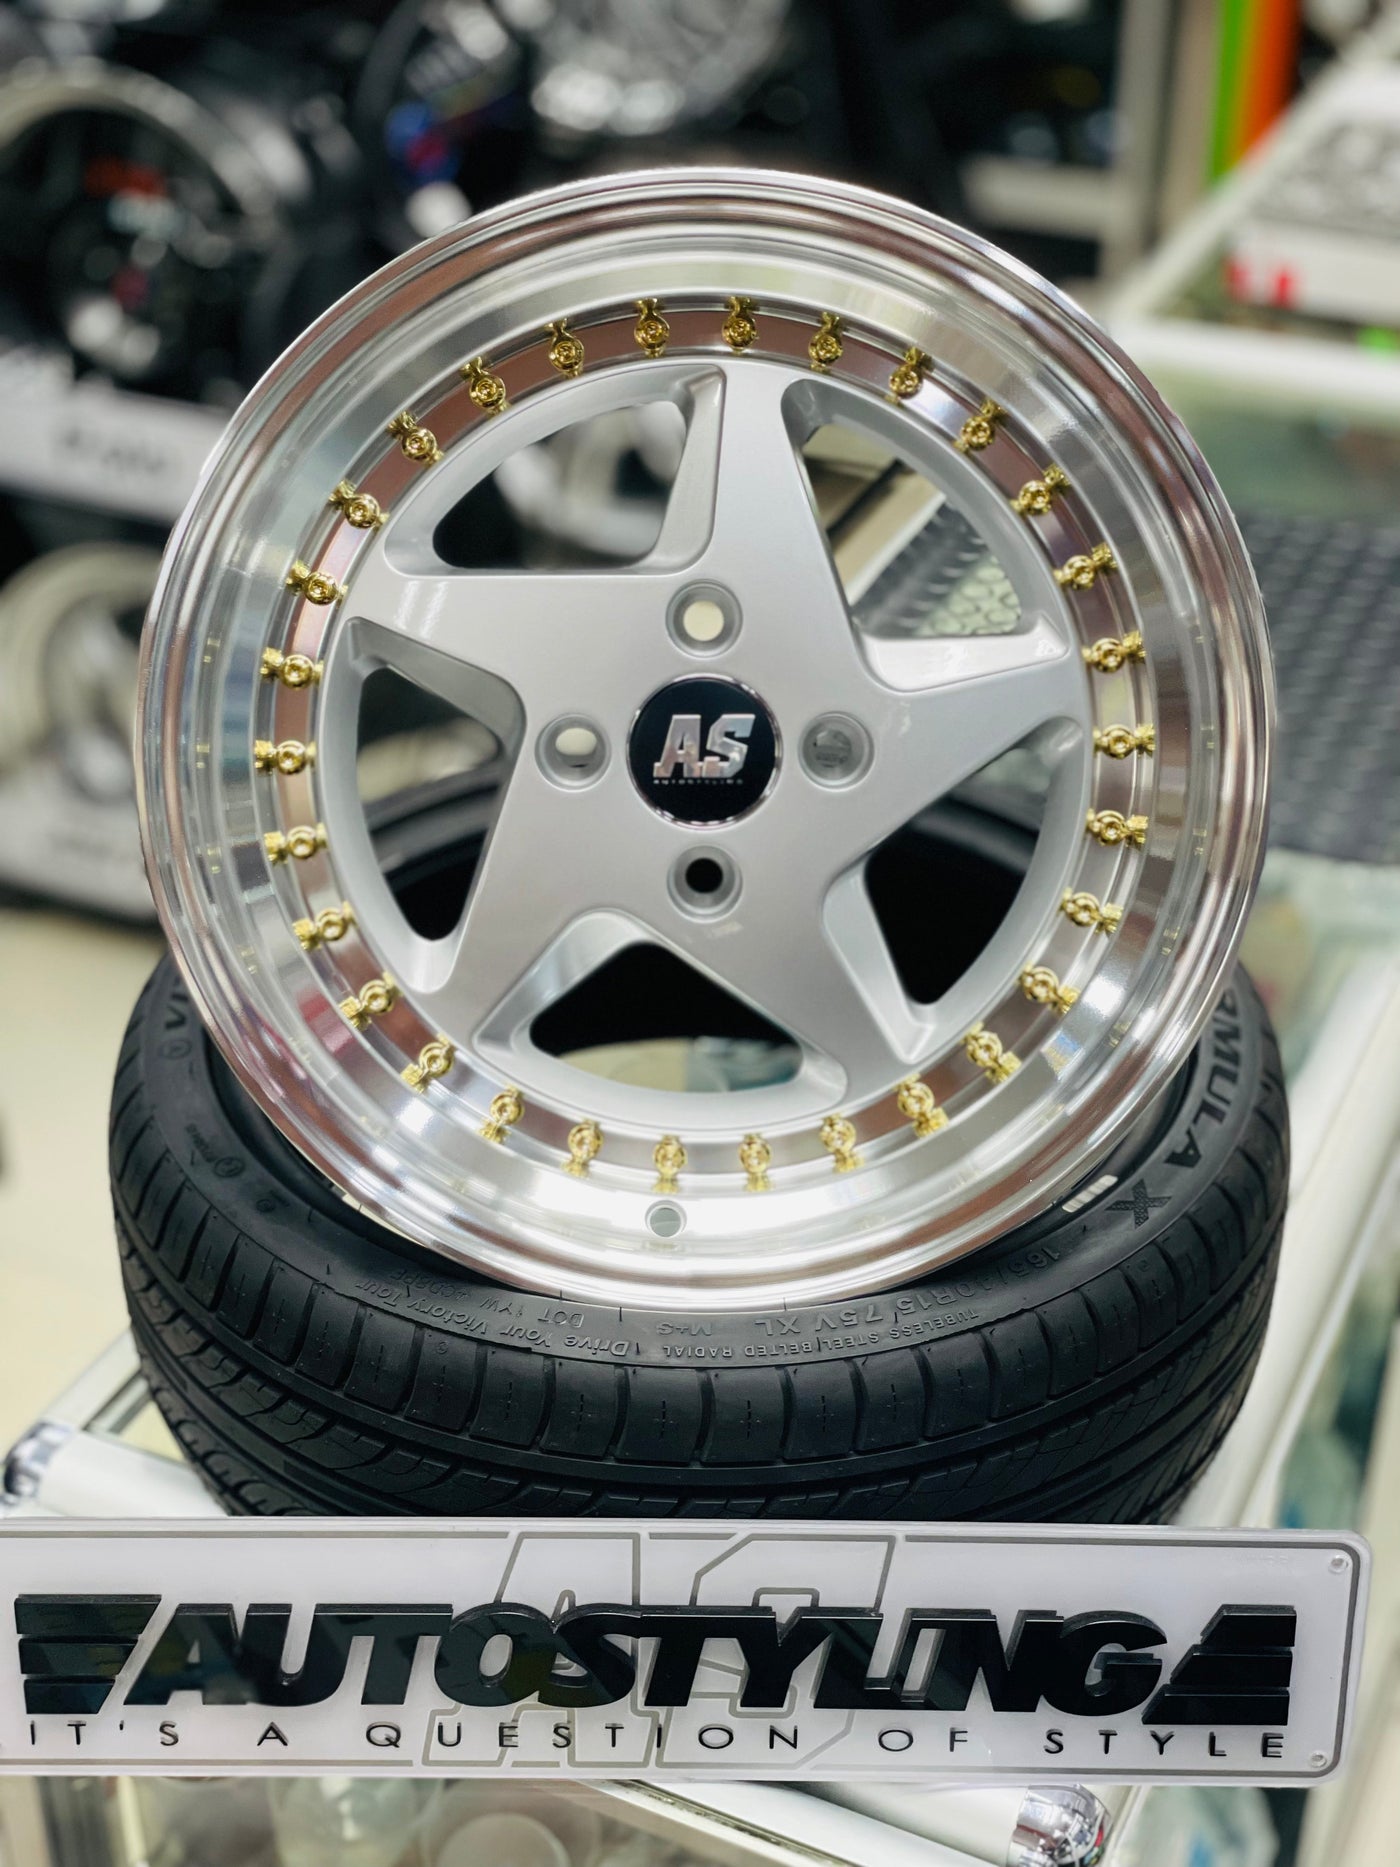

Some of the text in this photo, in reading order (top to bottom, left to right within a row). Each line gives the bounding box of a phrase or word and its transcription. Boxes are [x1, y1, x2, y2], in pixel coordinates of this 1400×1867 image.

[653, 713, 756, 778] AS
[1104, 1179, 1172, 1229] X
[352, 1279, 630, 1357] Drive Your Victory Tour
[536, 1307, 585, 1329] DOT
[662, 1309, 979, 1358] TUBELESS STEEL BELTED RADIAL
[753, 1315, 801, 1337] XL
[814, 1304, 884, 1331] 75V
[125, 1602, 1167, 1716] AUTOSTYLING
[30, 1719, 1284, 1758] IT'S A QUESTION OF STYLE
